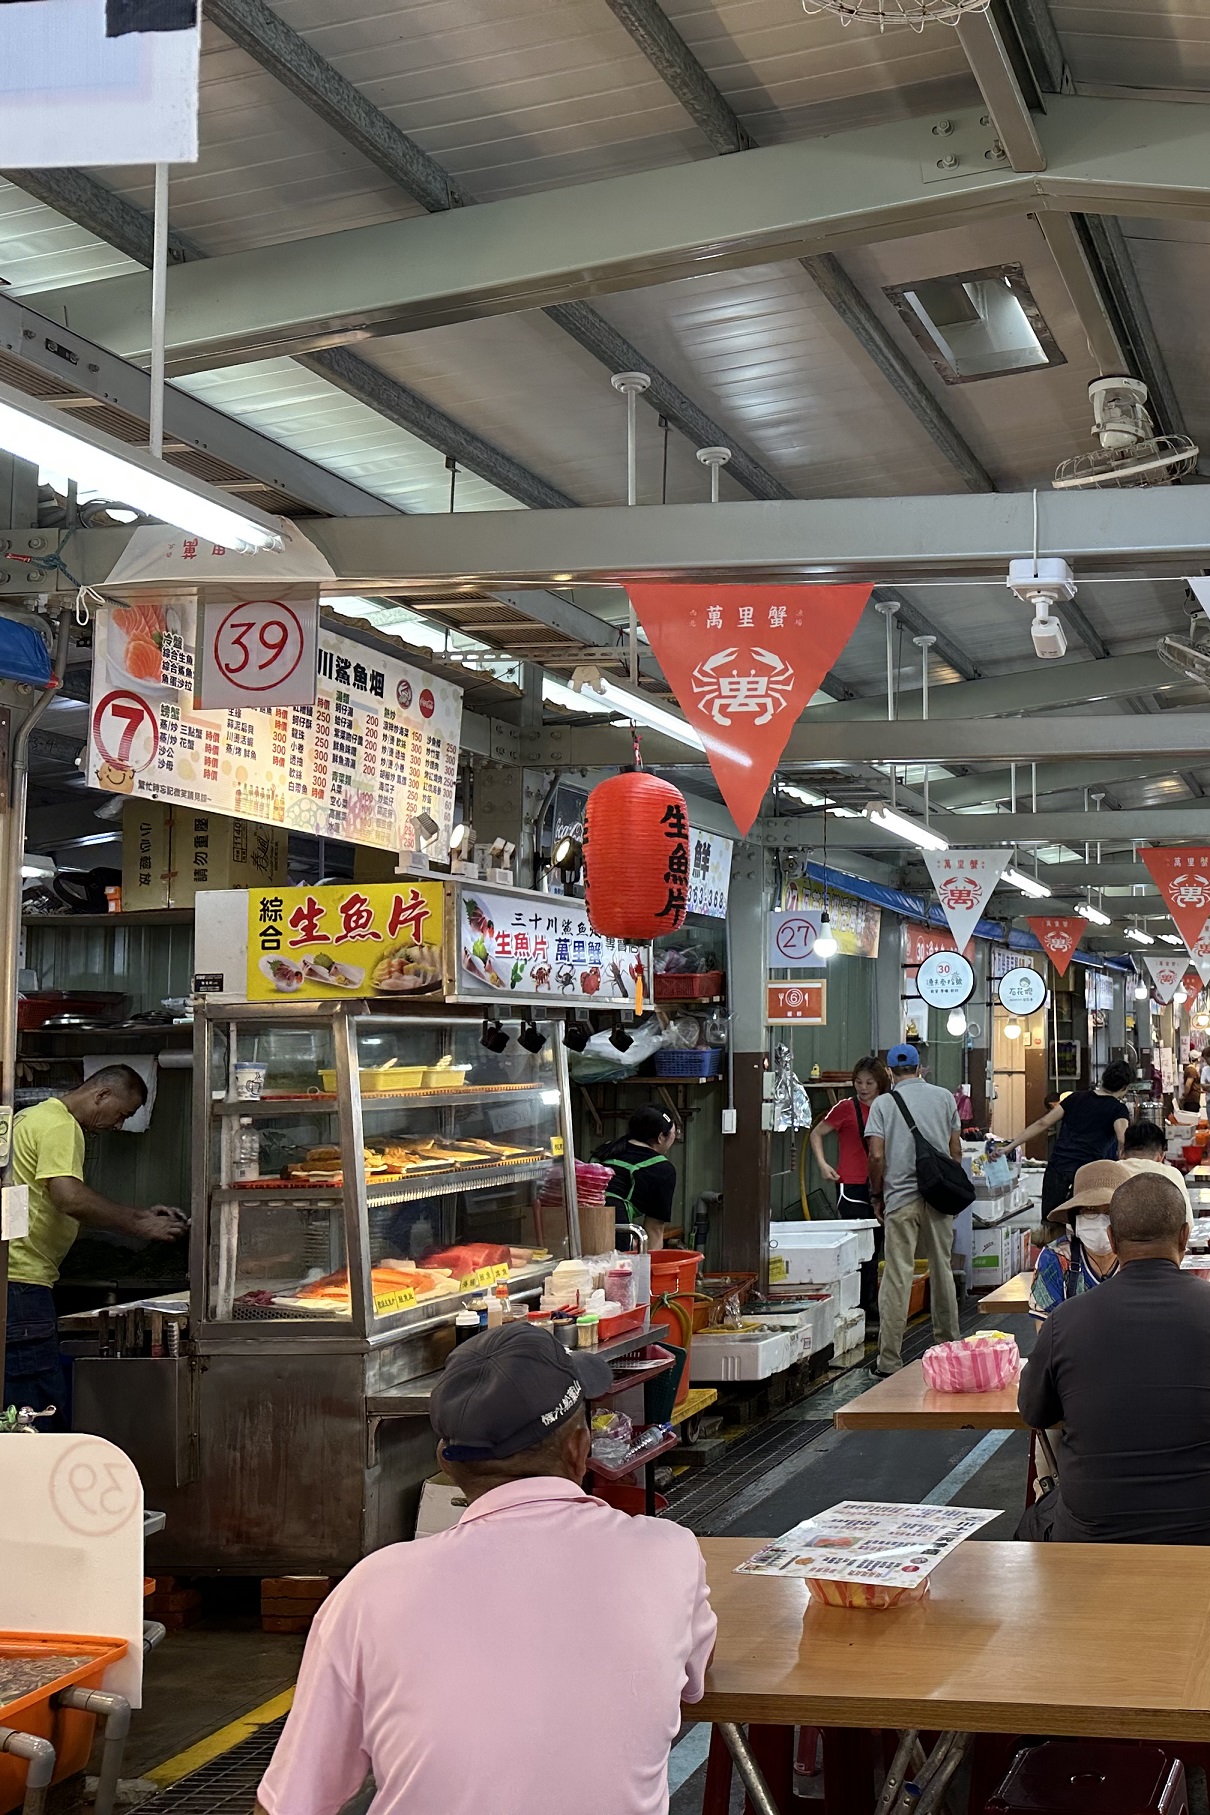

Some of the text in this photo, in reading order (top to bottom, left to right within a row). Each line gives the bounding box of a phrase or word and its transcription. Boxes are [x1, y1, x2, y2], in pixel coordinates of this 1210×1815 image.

[706, 605, 788, 629] 萬里蟹
[225, 619, 289, 675] 39
[316, 711, 331, 723] 250
[366, 714, 379, 727] 200
[111, 703, 145, 762] 7
[315, 723, 330, 736] 300
[365, 727, 378, 739] 200
[206, 730, 220, 743] 時價
[273, 732, 286, 743] 300
[314, 736, 329, 749] 250
[205, 743, 219, 756] 時價
[272, 744, 286, 755] 300
[364, 739, 377, 751] 200
[204, 756, 219, 768] 時價
[272, 756, 285, 768] 時價
[313, 750, 328, 762] 300
[364, 751, 376, 763] 200
[203, 768, 218, 781] 時價
[313, 762, 328, 775] 300
[363, 764, 376, 776] 200
[312, 775, 327, 788] 300
[311, 787, 325, 800] 時價
[193, 818, 209, 882] 請勿重壓
[655, 804, 689, 927] 生魚片
[692, 840, 711, 881] 鮮
[944, 859, 979, 870] 萬里蟹
[1173, 857, 1209, 867] 萬里蟹
[259, 889, 431, 950] 綜合 生魚片
[781, 926, 810, 948] 27
[495, 931, 548, 961] 生魚片
[555, 938, 602, 965] 萬里蟹
[938, 965, 950, 974] 30
[790, 993, 798, 1003] 6
